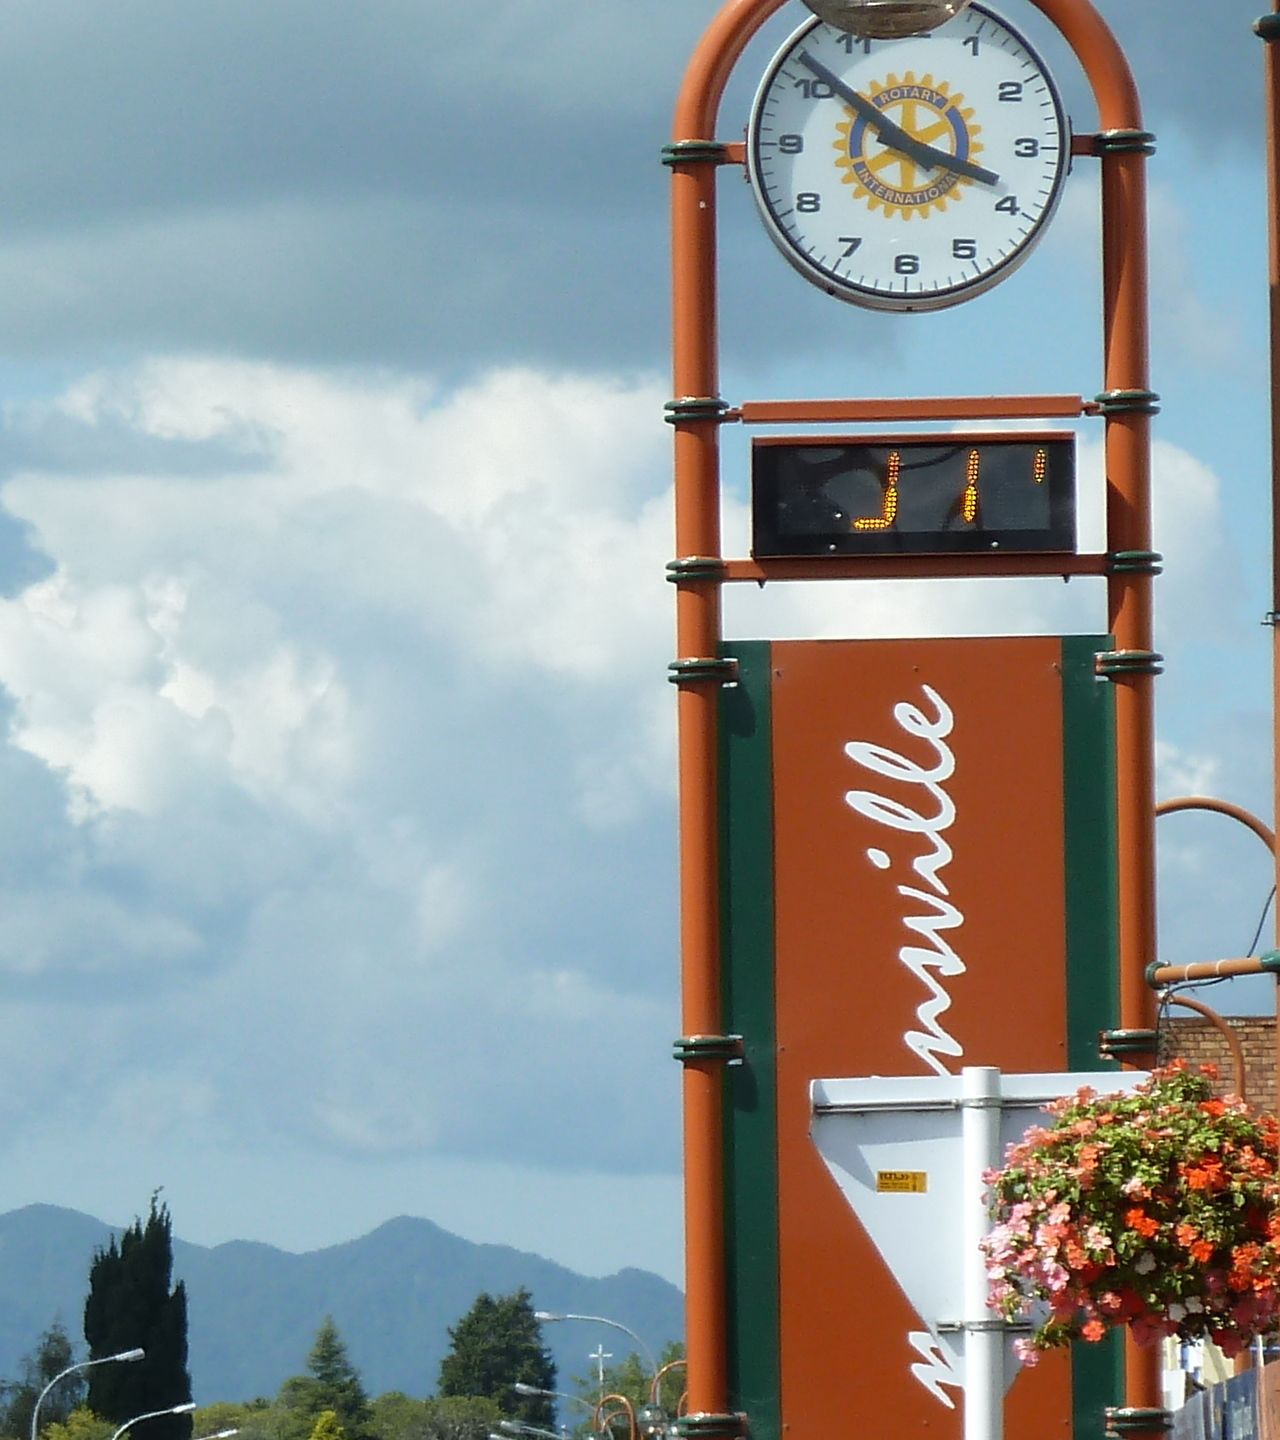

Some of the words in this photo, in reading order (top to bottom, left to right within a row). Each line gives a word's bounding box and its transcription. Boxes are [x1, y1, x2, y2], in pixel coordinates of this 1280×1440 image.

[962, 36, 980, 56] 1
[794, 78, 835, 99] 10
[879, 88, 942, 105] ROTARY
[998, 81, 1023, 102] 2
[778, 134, 803, 154] 9
[1014, 138, 1039, 158] 3
[796, 192, 821, 213] 8
[994, 195, 1020, 216] 4
[838, 237, 862, 258] 7
[952, 239, 977, 259] 5
[894, 255, 920, 275] 6
